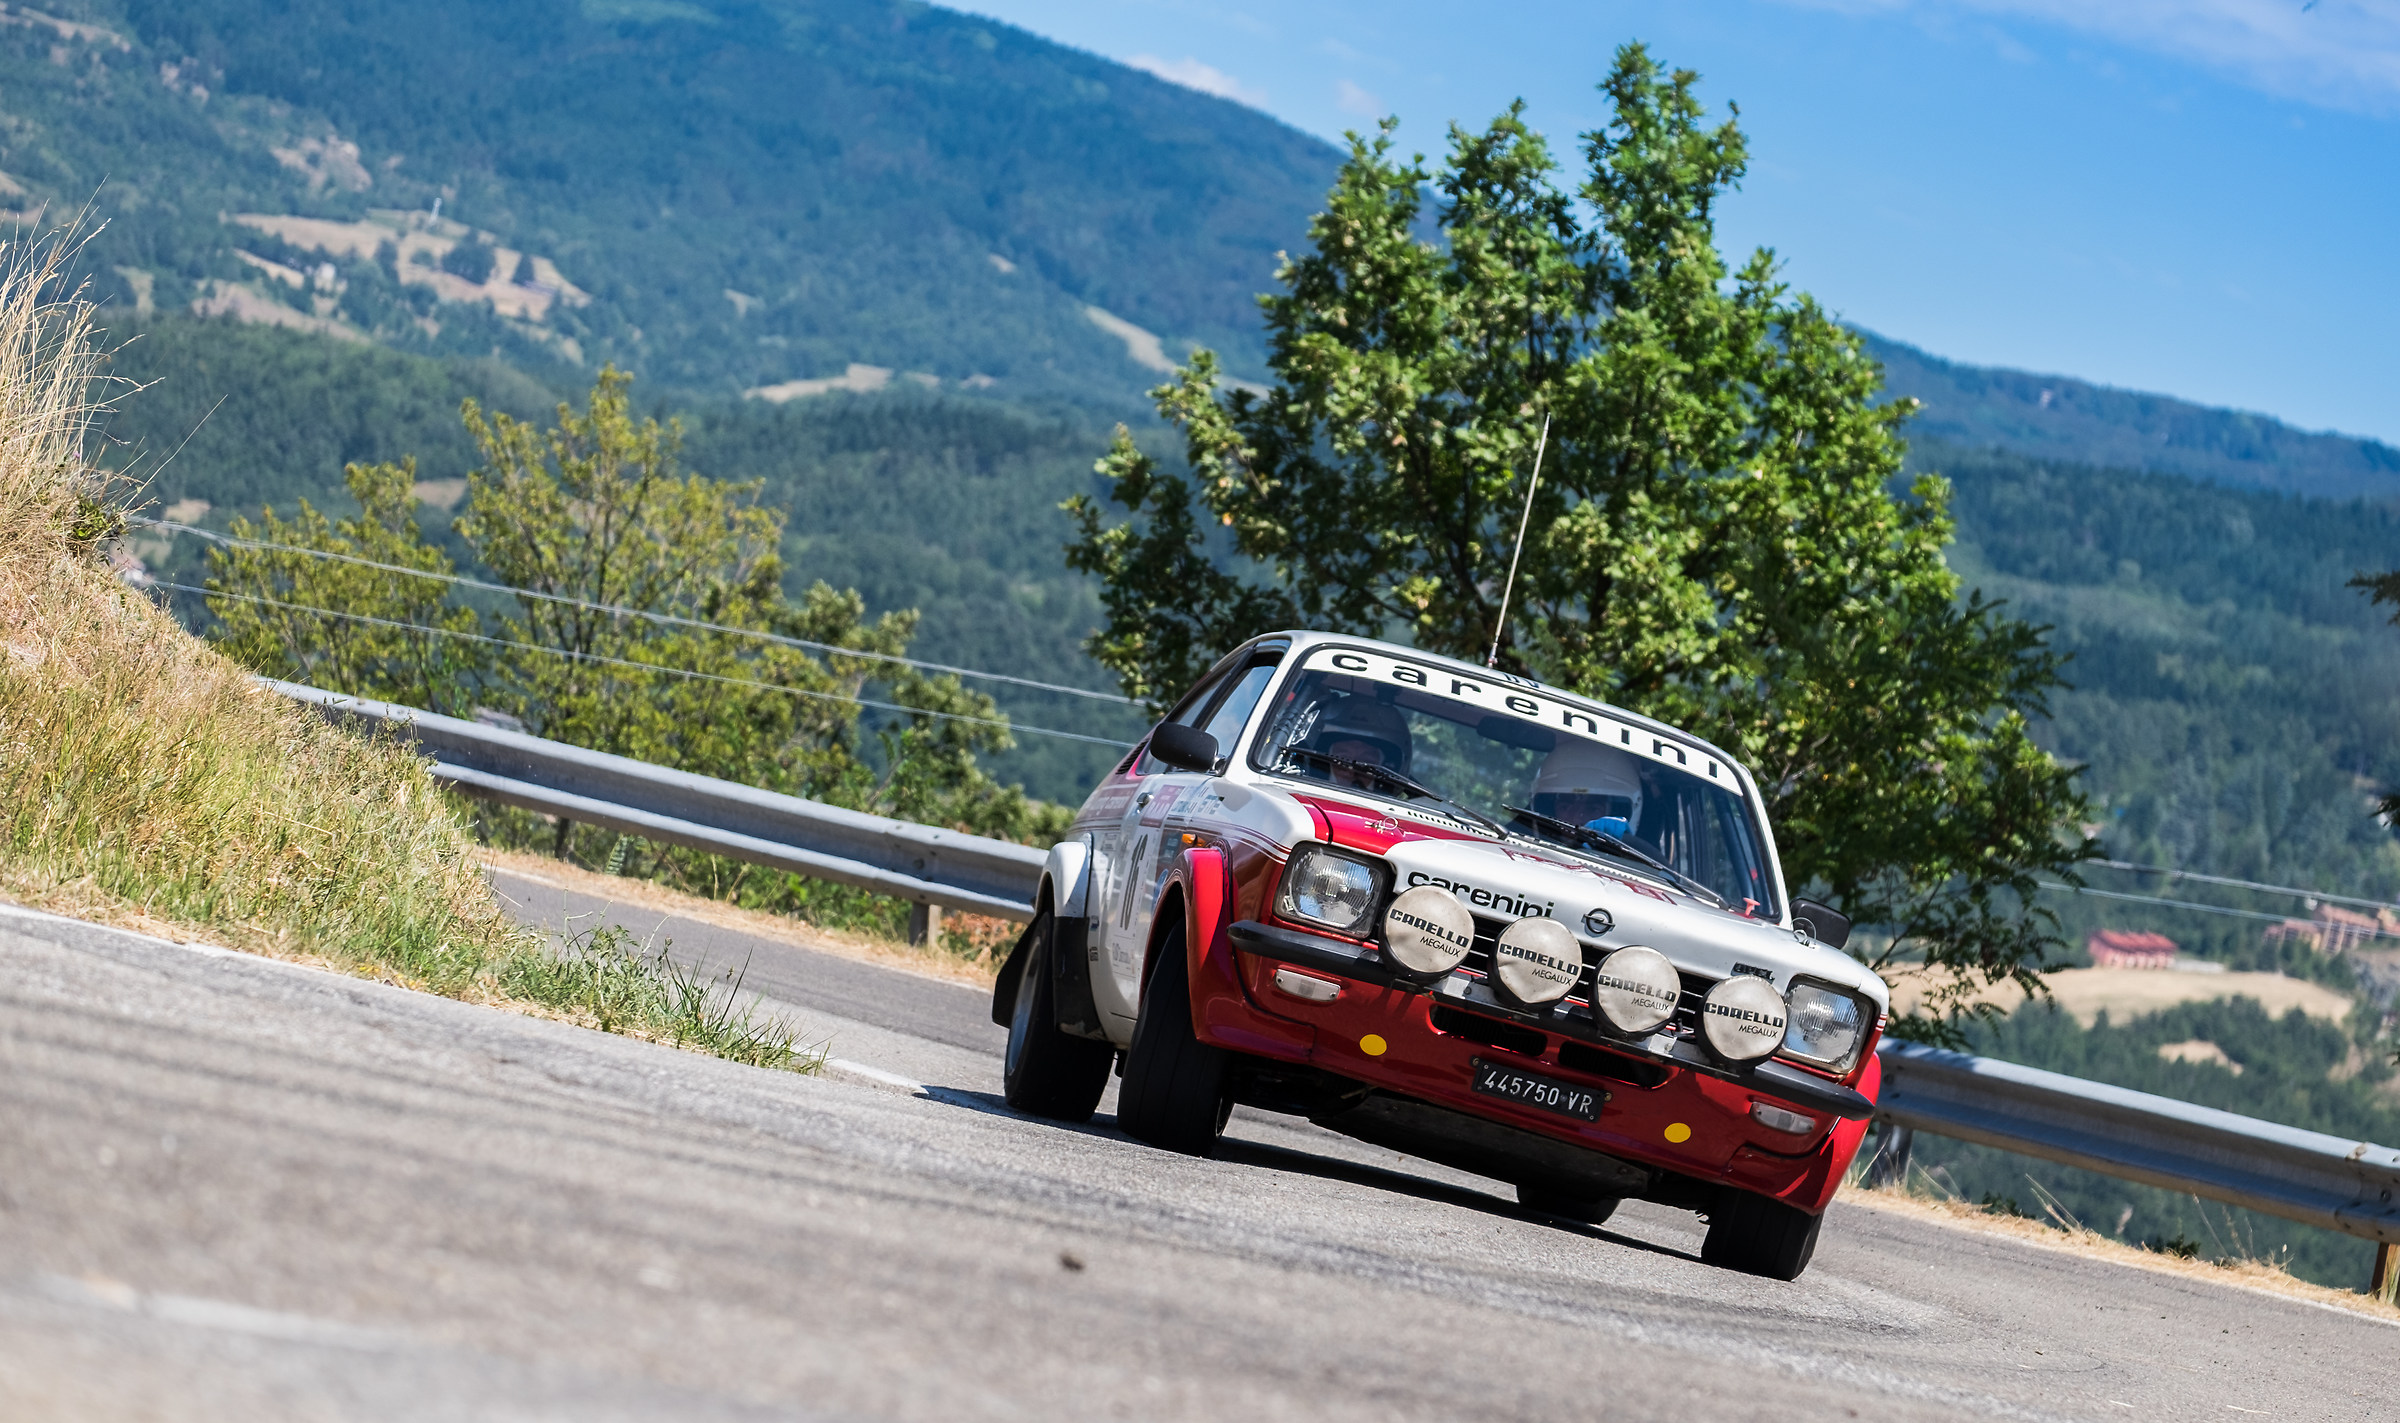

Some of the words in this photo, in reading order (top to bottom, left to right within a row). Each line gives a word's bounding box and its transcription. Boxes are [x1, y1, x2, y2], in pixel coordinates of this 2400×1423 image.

[1407, 872, 1555, 919] carenini
[1389, 908, 1470, 948] CARELLO
[1420, 936, 1461, 958] MEGALUX
[1499, 943, 1580, 976] CARELLO
[1531, 968, 1573, 986] MEGALUX
[1599, 974, 1677, 1003] CARELLO
[1631, 997, 1670, 1013] MEGALUX
[1704, 1003, 1784, 1028] CARELLO
[1738, 1024, 1779, 1039] MEGALUX
